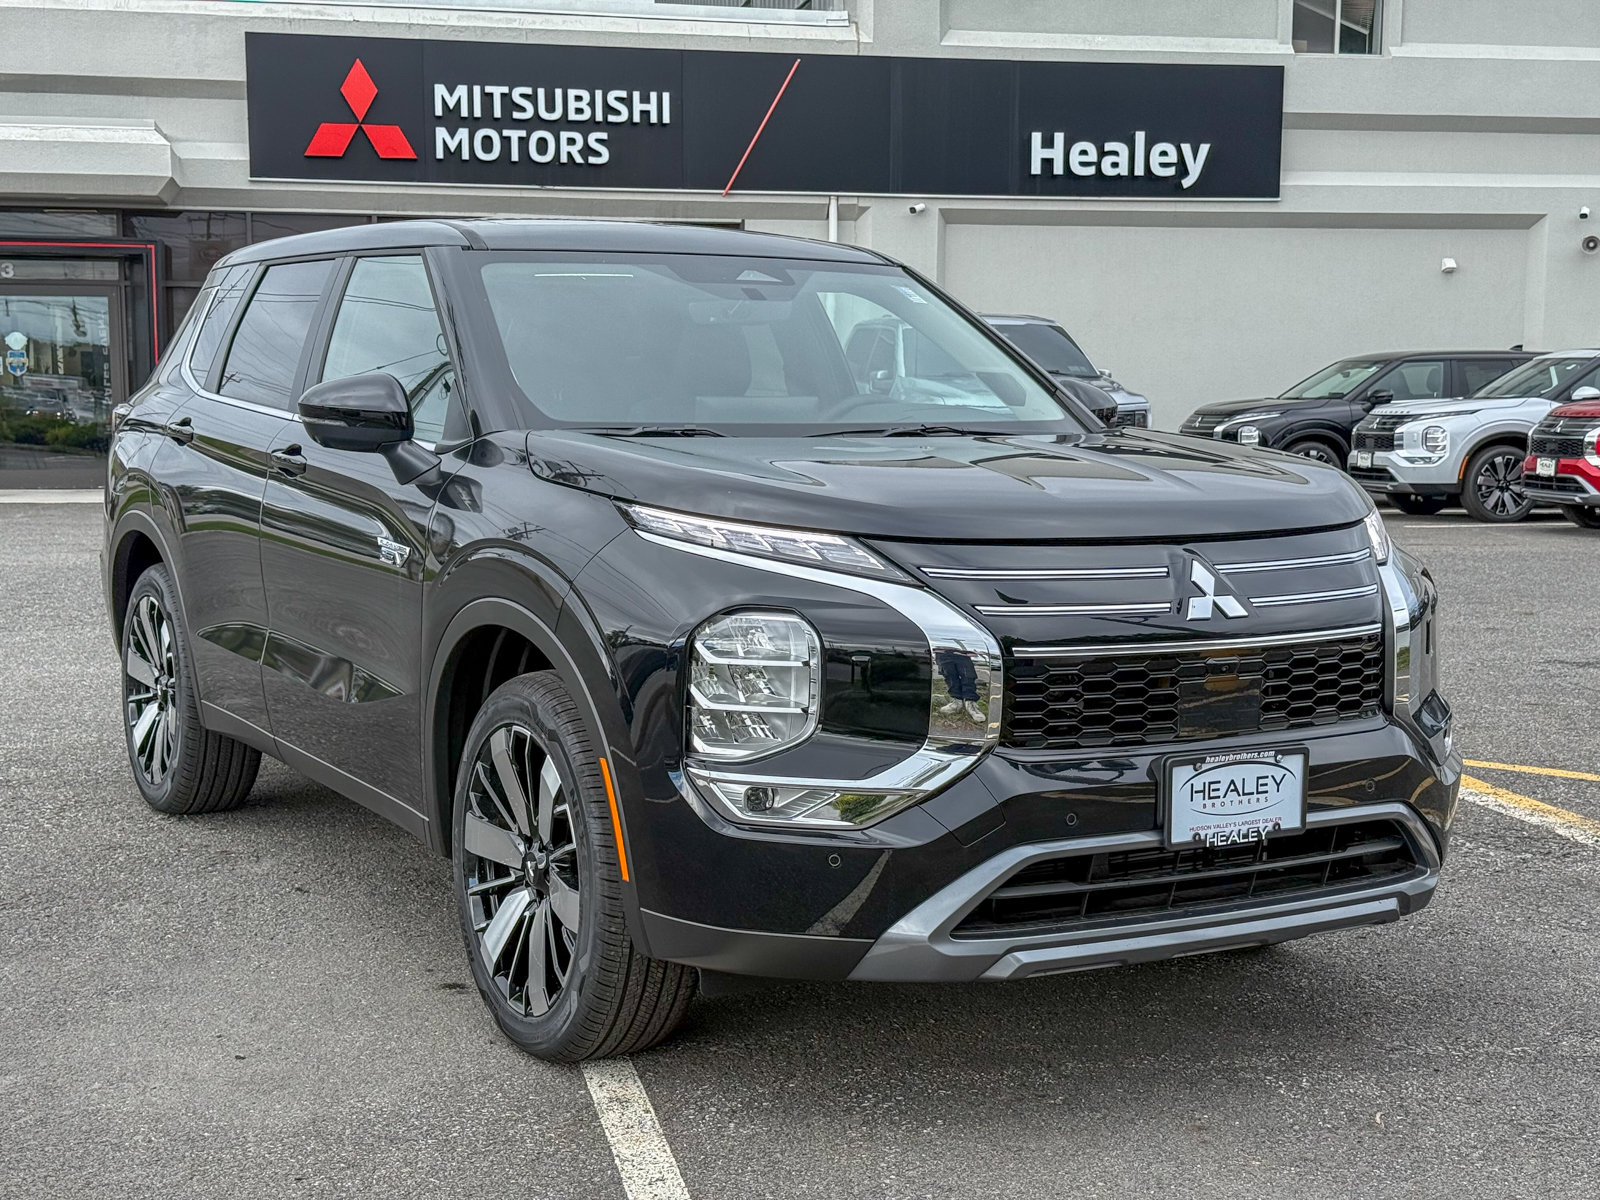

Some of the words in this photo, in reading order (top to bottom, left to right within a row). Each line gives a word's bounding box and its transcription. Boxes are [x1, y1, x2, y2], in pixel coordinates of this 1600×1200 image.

[434, 83, 671, 124] MITSUBISHI
[435, 126, 610, 165] MOTORS
[1030, 130, 1212, 190] Healey
[1206, 751, 1275, 762] healeybrothers.com
[1190, 773, 1287, 802] HEALEY
[1203, 797, 1268, 809] BROTHERS
[1189, 824, 1212, 832] HUDSON
[1212, 821, 1237, 829] VALLEY'S
[1237, 818, 1261, 827] LARGEST
[1206, 826, 1269, 847] HEALEY
